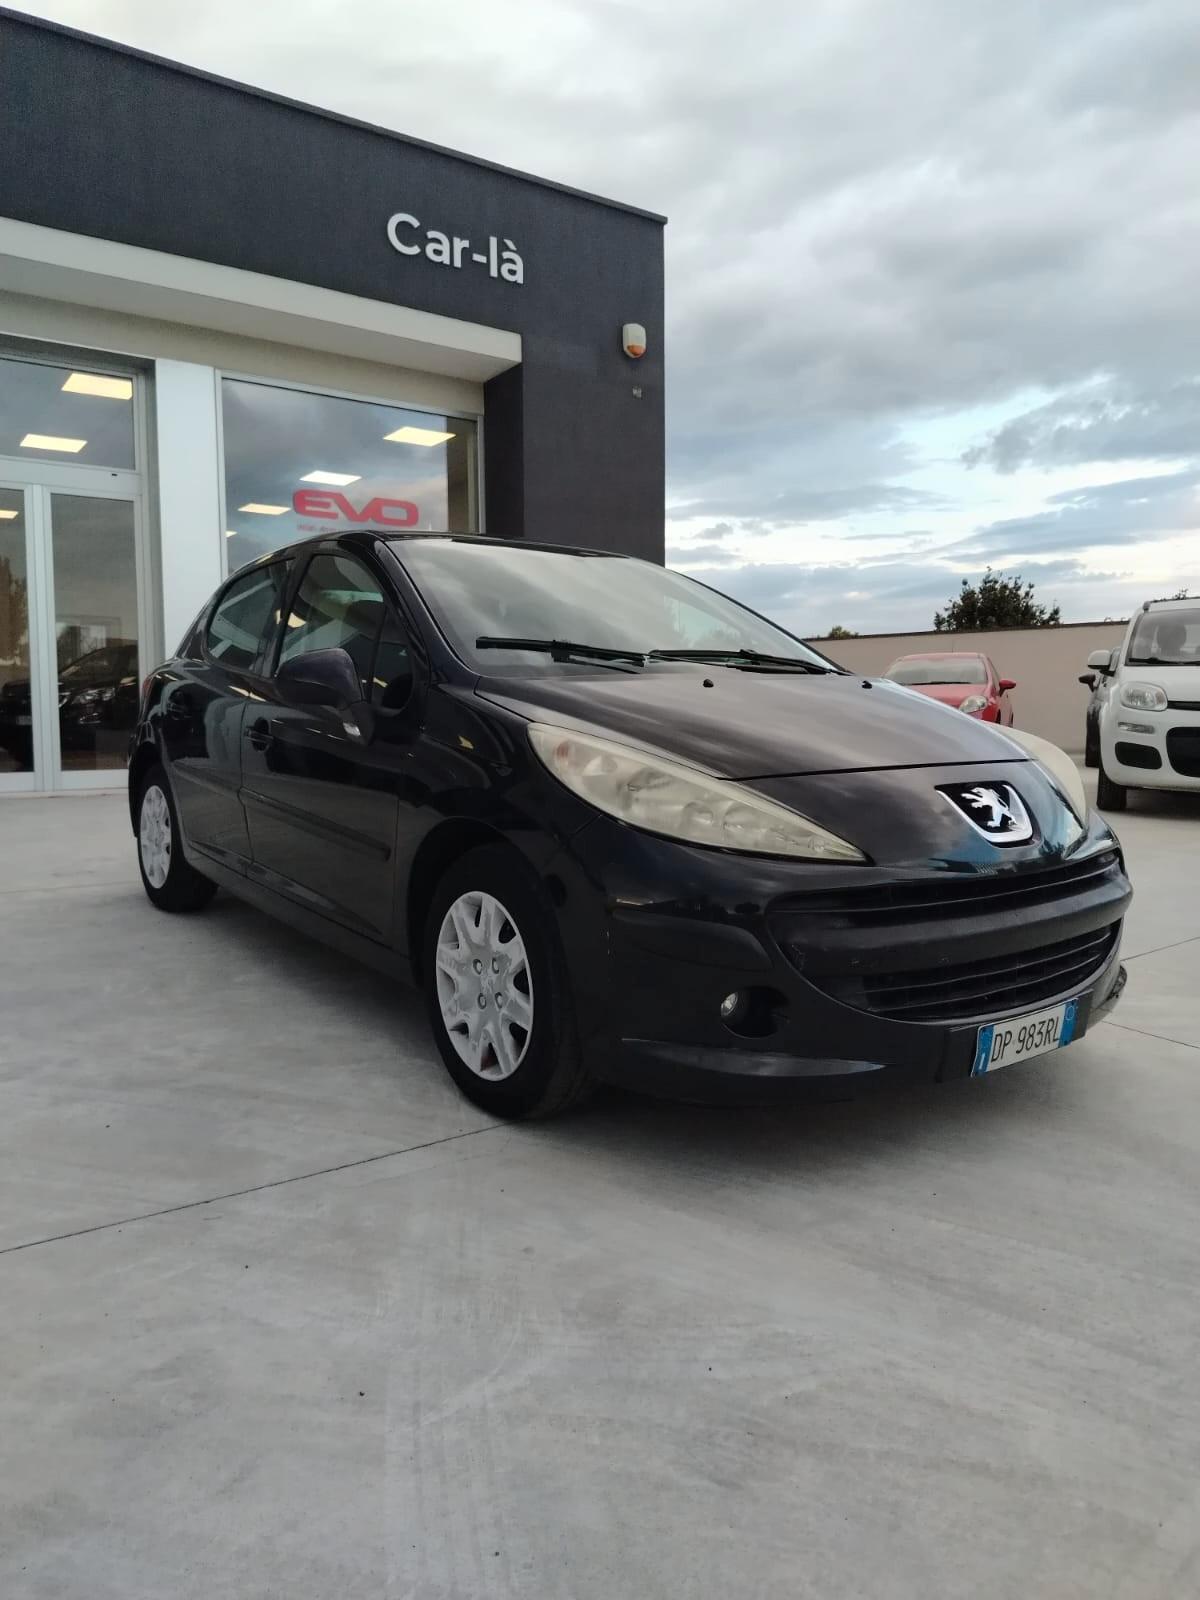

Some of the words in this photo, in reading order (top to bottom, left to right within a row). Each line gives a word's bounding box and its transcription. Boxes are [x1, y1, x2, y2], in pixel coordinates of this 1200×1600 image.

[386, 212, 524, 285] Car-là
[292, 489, 419, 527] EVO
[991, 1030, 1013, 1064] DP
[1015, 1016, 1060, 1055] 983RL
